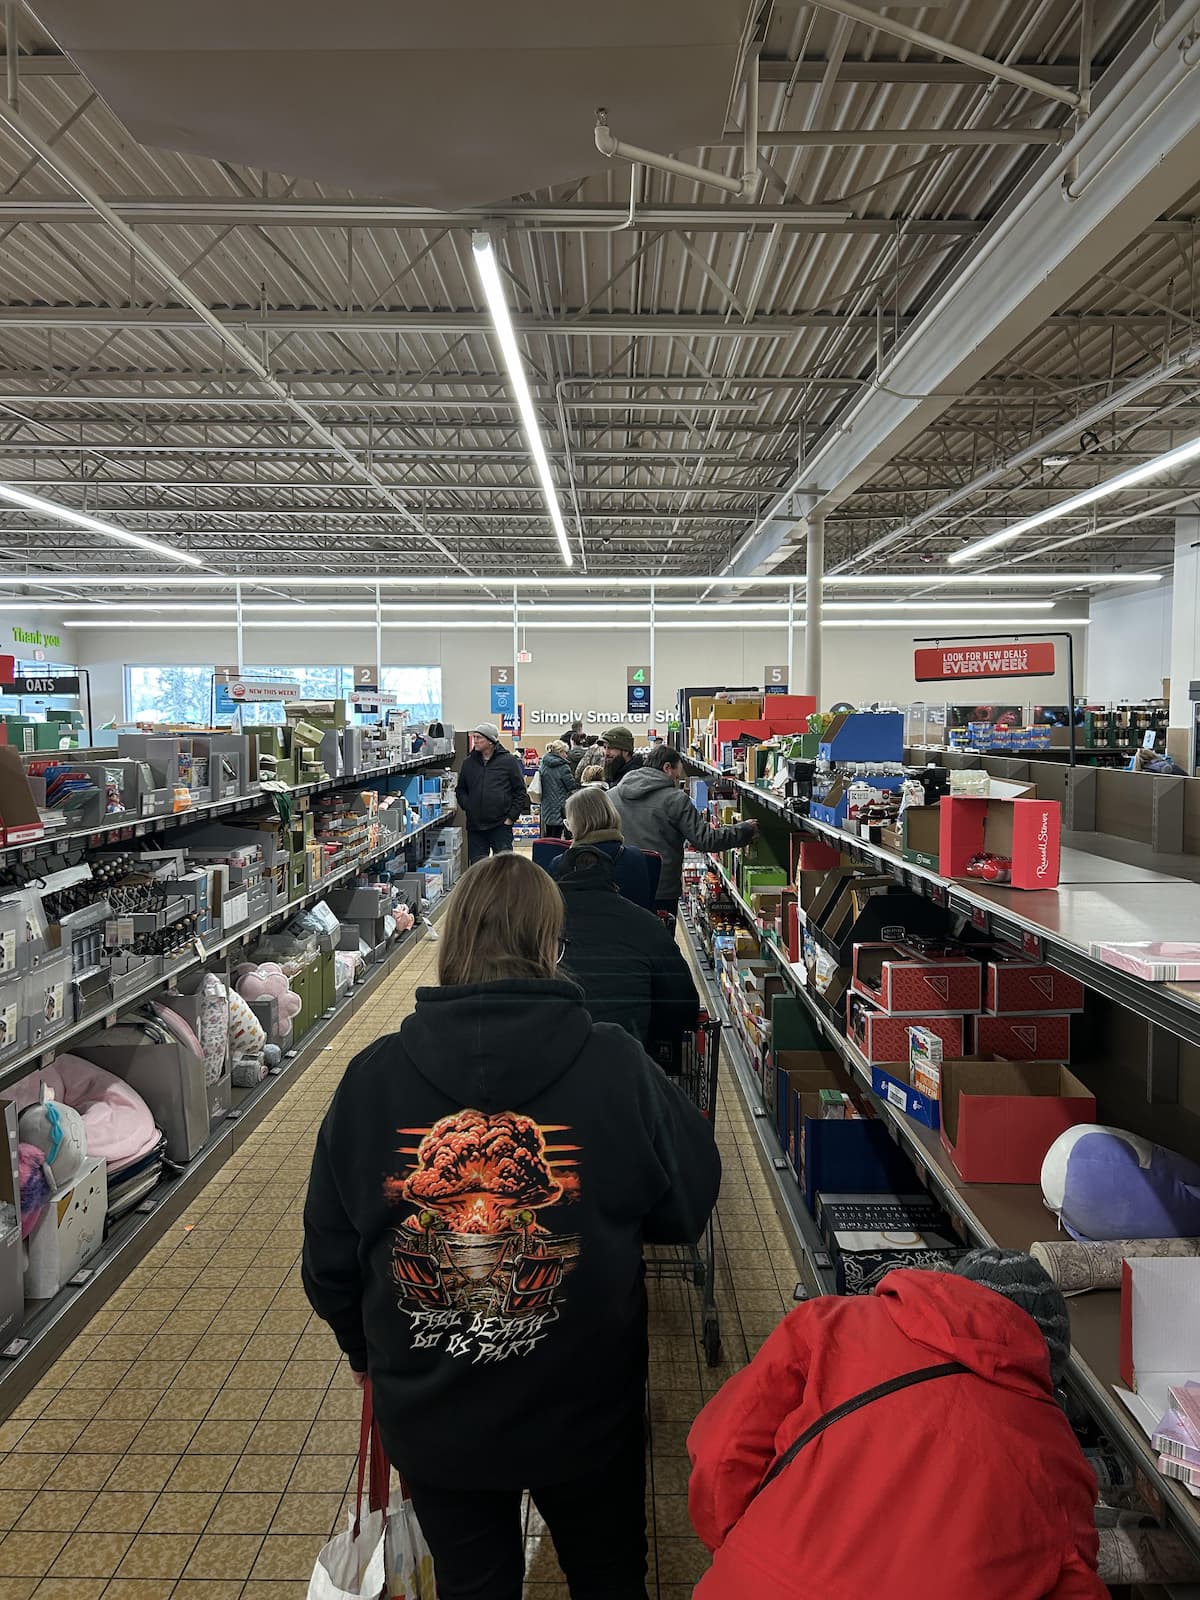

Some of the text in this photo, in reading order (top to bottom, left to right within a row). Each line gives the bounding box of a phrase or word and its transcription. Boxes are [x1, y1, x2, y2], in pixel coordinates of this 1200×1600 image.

[12, 627, 61, 648] Thank you
[943, 649, 1028, 661] LOOK FOR NEW DEALS
[222, 668, 230, 682] 1
[360, 669, 371, 683] 2
[498, 669, 508, 683] 3
[632, 668, 645, 683] 4
[772, 668, 782, 682] 5
[26, 679, 55, 692] OATS
[503, 720, 521, 728] ALI
[530, 710, 583, 725] Simply
[587, 710, 650, 724] Smarter
[1036, 842, 1049, 878] Russell
[410, 1310, 549, 1341] TILL DEATH
[410, 1331, 548, 1364] DO US PART
